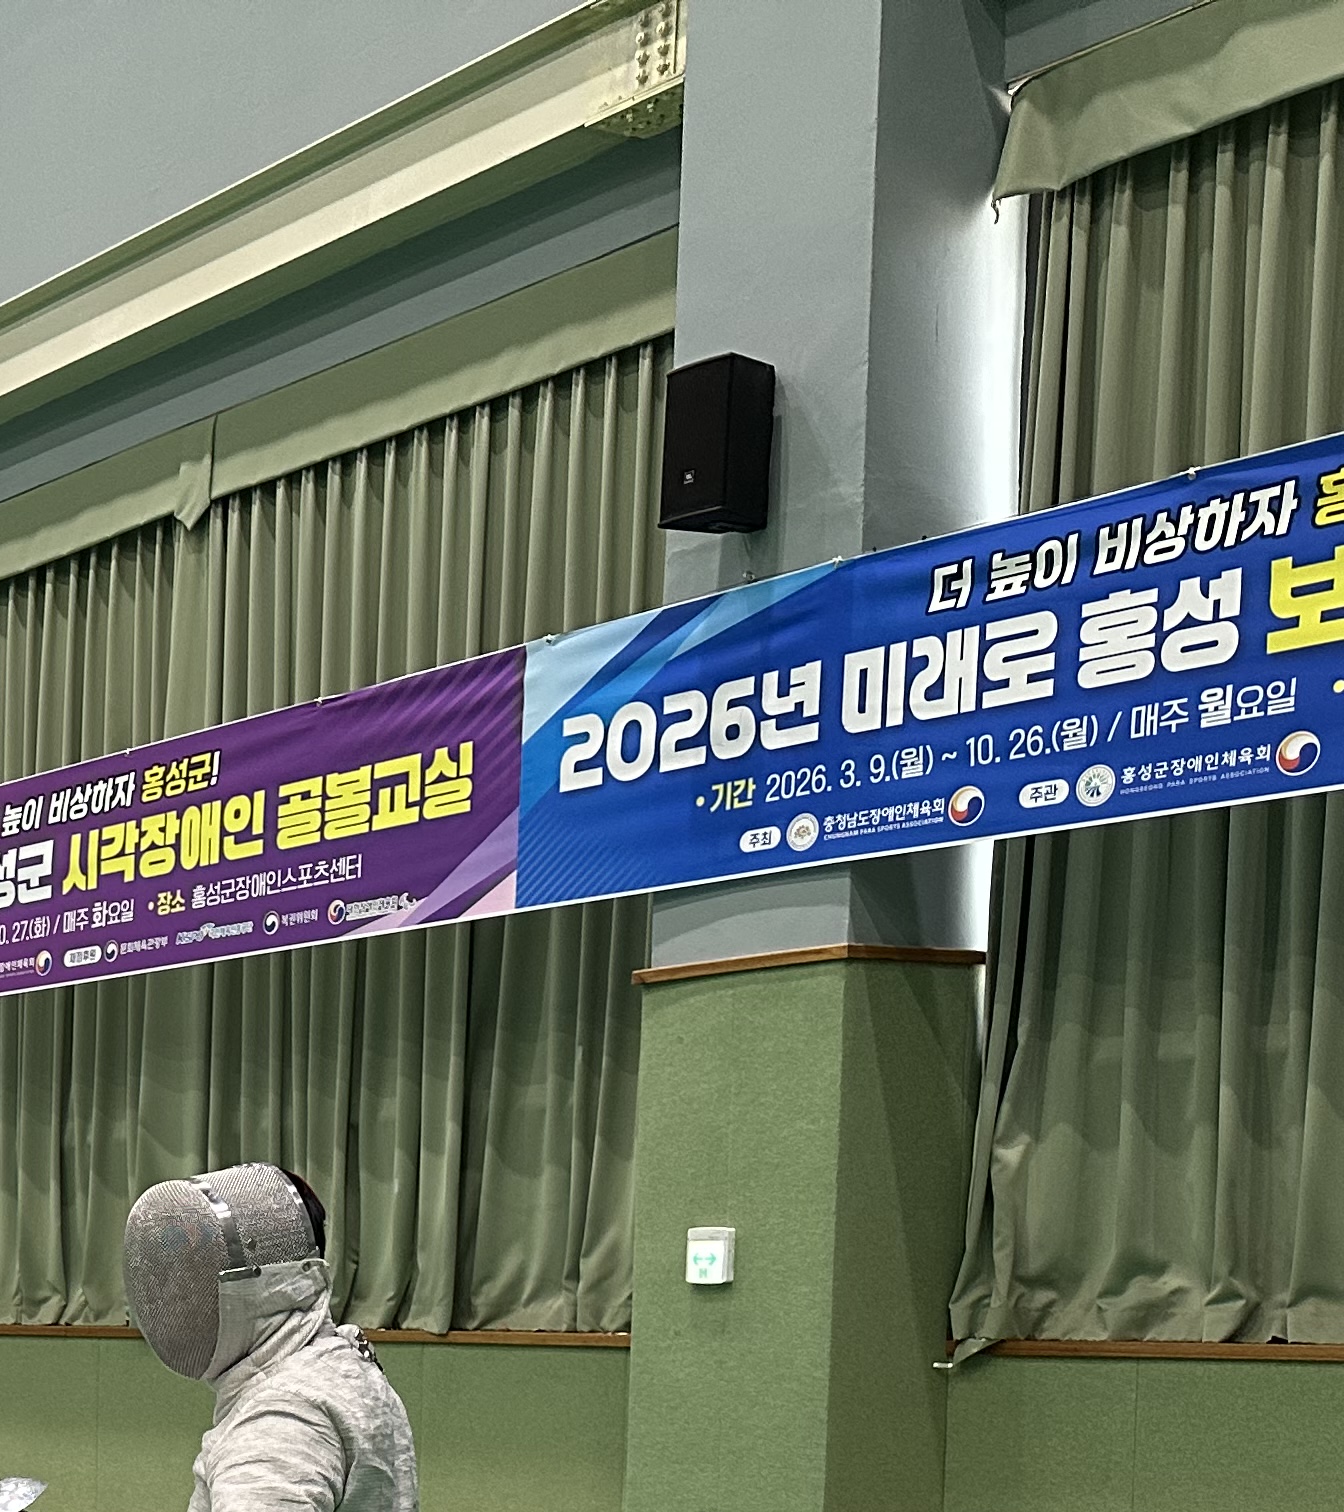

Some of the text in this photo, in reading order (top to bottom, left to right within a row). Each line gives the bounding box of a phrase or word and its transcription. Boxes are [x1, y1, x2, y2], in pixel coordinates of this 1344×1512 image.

[927, 559, 973, 614] 더
[985, 532, 1079, 603] 높이
[1092, 479, 1298, 577] 비상하자
[559, 660, 822, 794] 2026년
[842, 609, 1059, 734] 미래로
[1076, 567, 1243, 691] 홍성
[709, 778, 757, 812] 기간
[765, 764, 832, 803] 2026.
[840, 762, 866, 787] 3.
[870, 743, 935, 782] 9.(월)
[965, 734, 1001, 768] 10.
[1009, 714, 1099, 761] 26.(월)
[1130, 697, 1189, 740] 매주
[1198, 677, 1298, 729] 월요일
[1120, 744, 1271, 785] 홍성군장애인체육회
[1, 801, 41, 838] 높이
[47, 771, 136, 823] 비상하자
[141, 751, 221, 803] 홍성군!
[62, 790, 265, 895] 시각장애인
[275, 740, 474, 851] 골볼교실
[823, 797, 946, 834] 충청남도장애인체육회
[1029, 784, 1059, 803] 주관
[12, 915, 50, 944] 27.(화)
[63, 911, 89, 934] 매주
[91, 899, 135, 929] 화요일
[156, 889, 186, 916] 장소
[191, 854, 363, 910] 홍성군장애인스포츠센터
